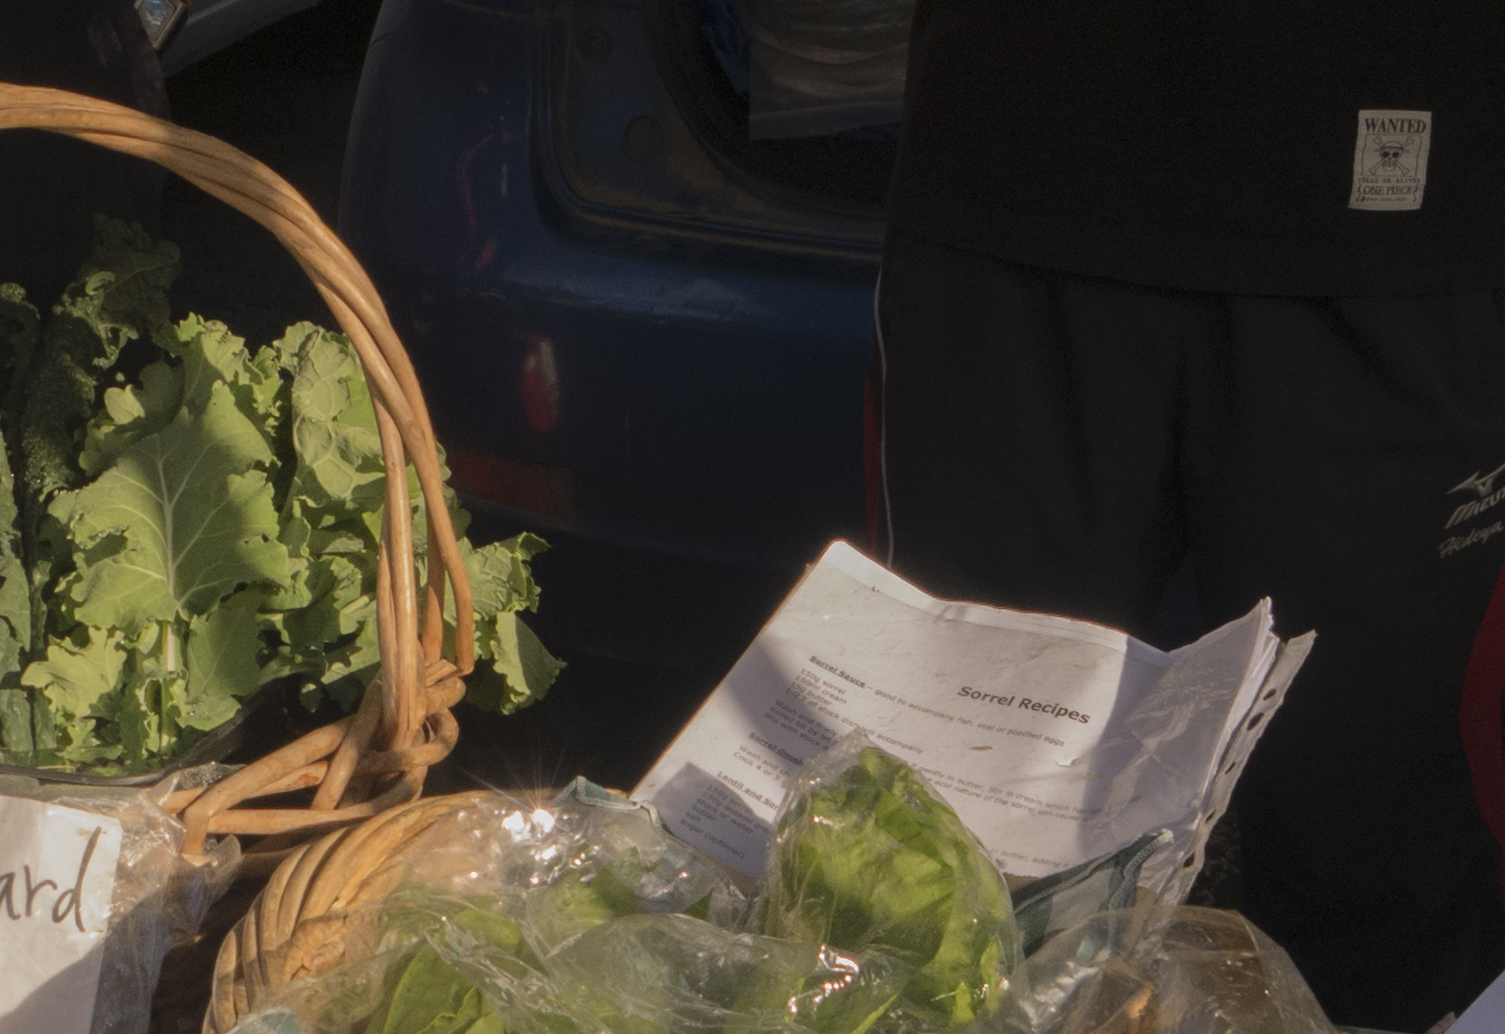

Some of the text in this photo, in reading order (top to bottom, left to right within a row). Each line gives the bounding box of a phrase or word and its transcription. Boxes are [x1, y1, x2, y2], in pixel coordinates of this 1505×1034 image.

[1364, 118, 1427, 134] WANTED
[1362, 185, 1413, 196] ONE PIECE
[790, 681, 833, 706] 15g butter
[796, 675, 847, 705] 150ml cream
[800, 668, 846, 695] 150g sorrel
[775, 700, 797, 715] Wash
[798, 713, 815, 725] and
[809, 655, 839, 676] Sorrel
[839, 669, 866, 689] Sauce
[874, 688, 896, 703] good
[897, 697, 907, 706] to
[908, 701, 955, 723] accompany
[977, 722, 995, 731] veal
[1007, 728, 1043, 741] poached
[1044, 735, 1065, 747] eggs
[957, 685, 1091, 725] Sorrel Recipes
[808, 699, 817, 707] of
[818, 705, 840, 720] stock
[876, 733, 924, 755] accompany
[748, 731, 777, 755] Sorrel
[733, 751, 755, 768] Cook
[763, 768, 774, 777] or
[738, 745, 780, 771] Wash and
[716, 771, 745, 793] Lentil
[745, 787, 763, 803] and
[918, 766, 945, 780] gently
[1015, 793, 1043, 806] cream
[933, 776, 952, 789] acid
[953, 786, 982, 800] nature
[983, 793, 994, 801] of
[994, 795, 1009, 806] the
